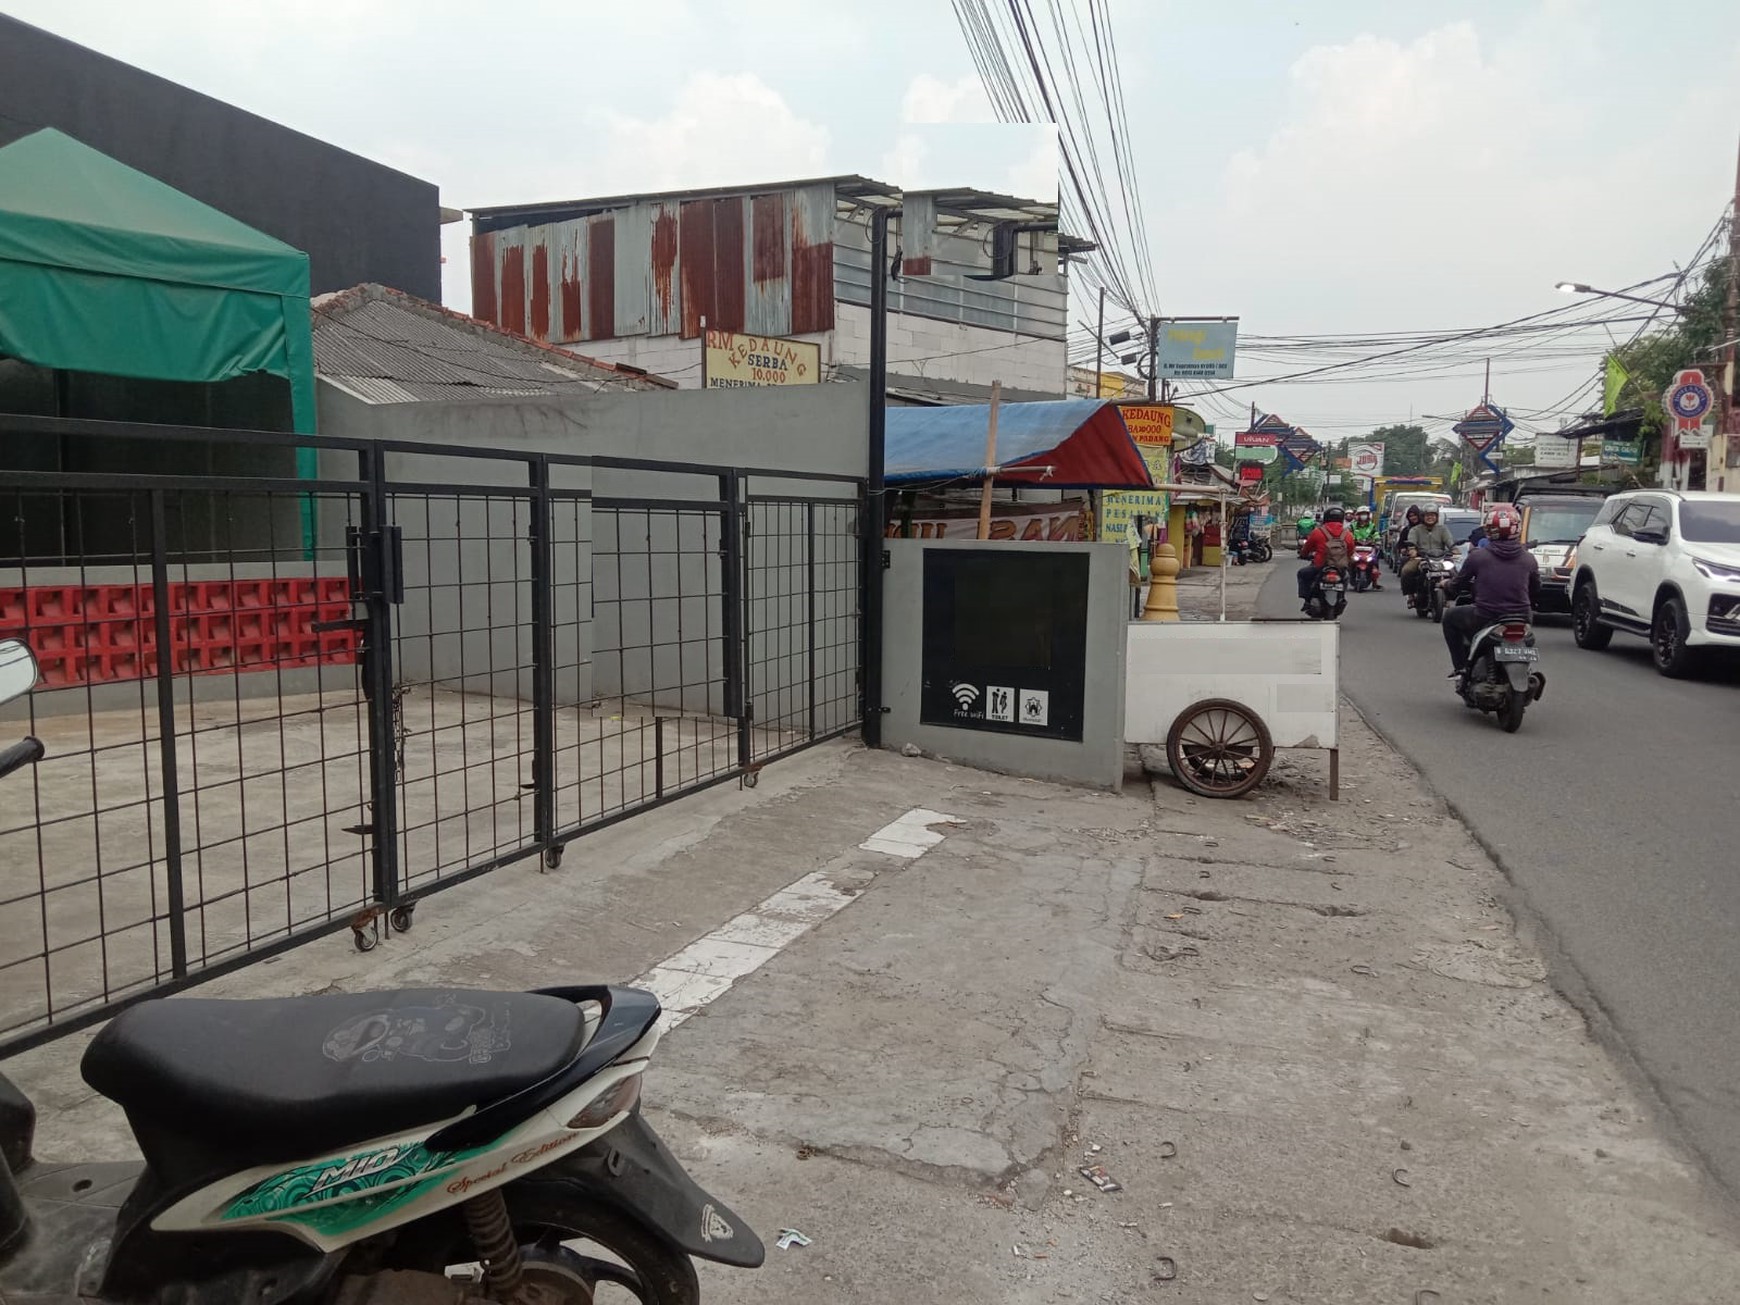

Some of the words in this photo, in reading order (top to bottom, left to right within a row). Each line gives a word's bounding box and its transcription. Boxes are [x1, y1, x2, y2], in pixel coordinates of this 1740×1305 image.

[706, 330, 733, 351] RM
[728, 338, 807, 377] KEDAUNG
[748, 353, 788, 371] SERBA
[753, 368, 786, 384] 10.000
[1122, 408, 1171, 428] KEDAUNG
[953, 709, 969, 718] Free
[311, 1148, 400, 1191] MIO
[447, 1162, 508, 1194] Special
[511, 1130, 580, 1163] Edition
